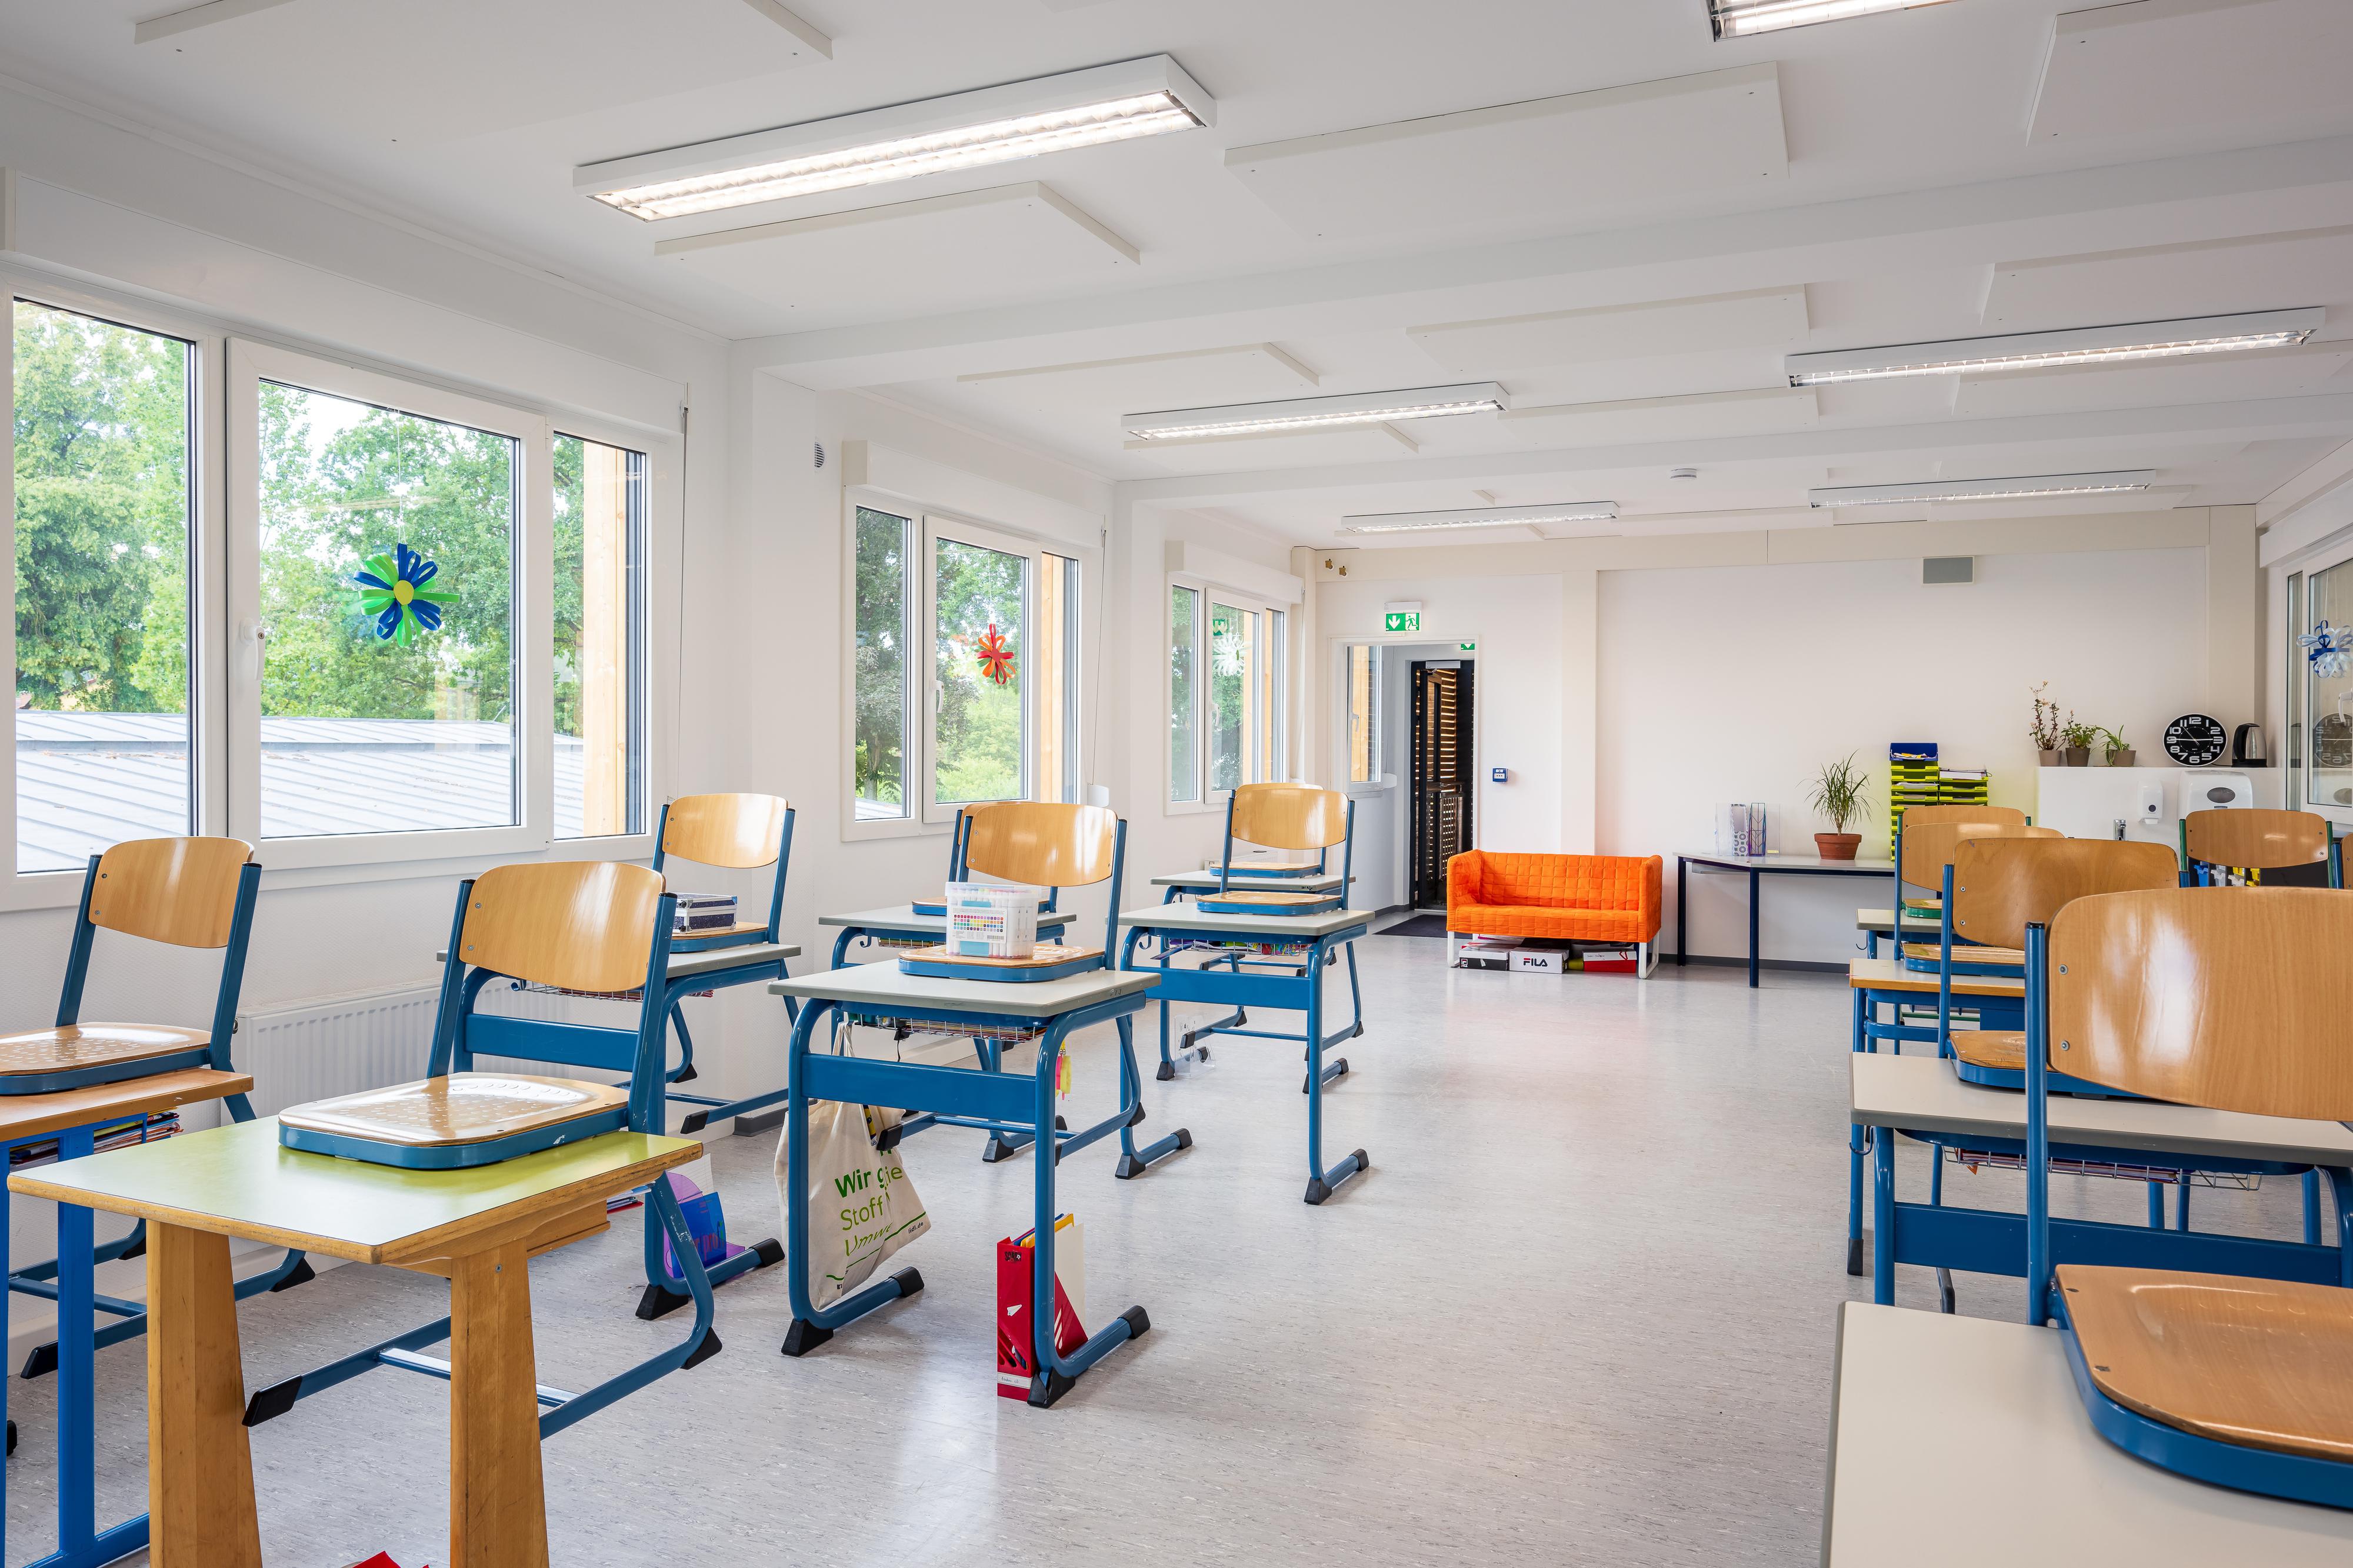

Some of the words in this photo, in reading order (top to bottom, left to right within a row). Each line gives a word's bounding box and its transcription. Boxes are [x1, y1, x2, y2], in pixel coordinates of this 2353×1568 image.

[2189, 716, 2202, 725] 12
[2169, 726, 2181, 735] 10
[2210, 726, 2221, 735] 2
[1524, 958, 1548, 966] FILA
[835, 1168, 871, 1199] Wir
[841, 1195, 883, 1231] Stoff
[908, 1222, 924, 1234] lidl.de
[845, 1222, 893, 1256] Umwe
